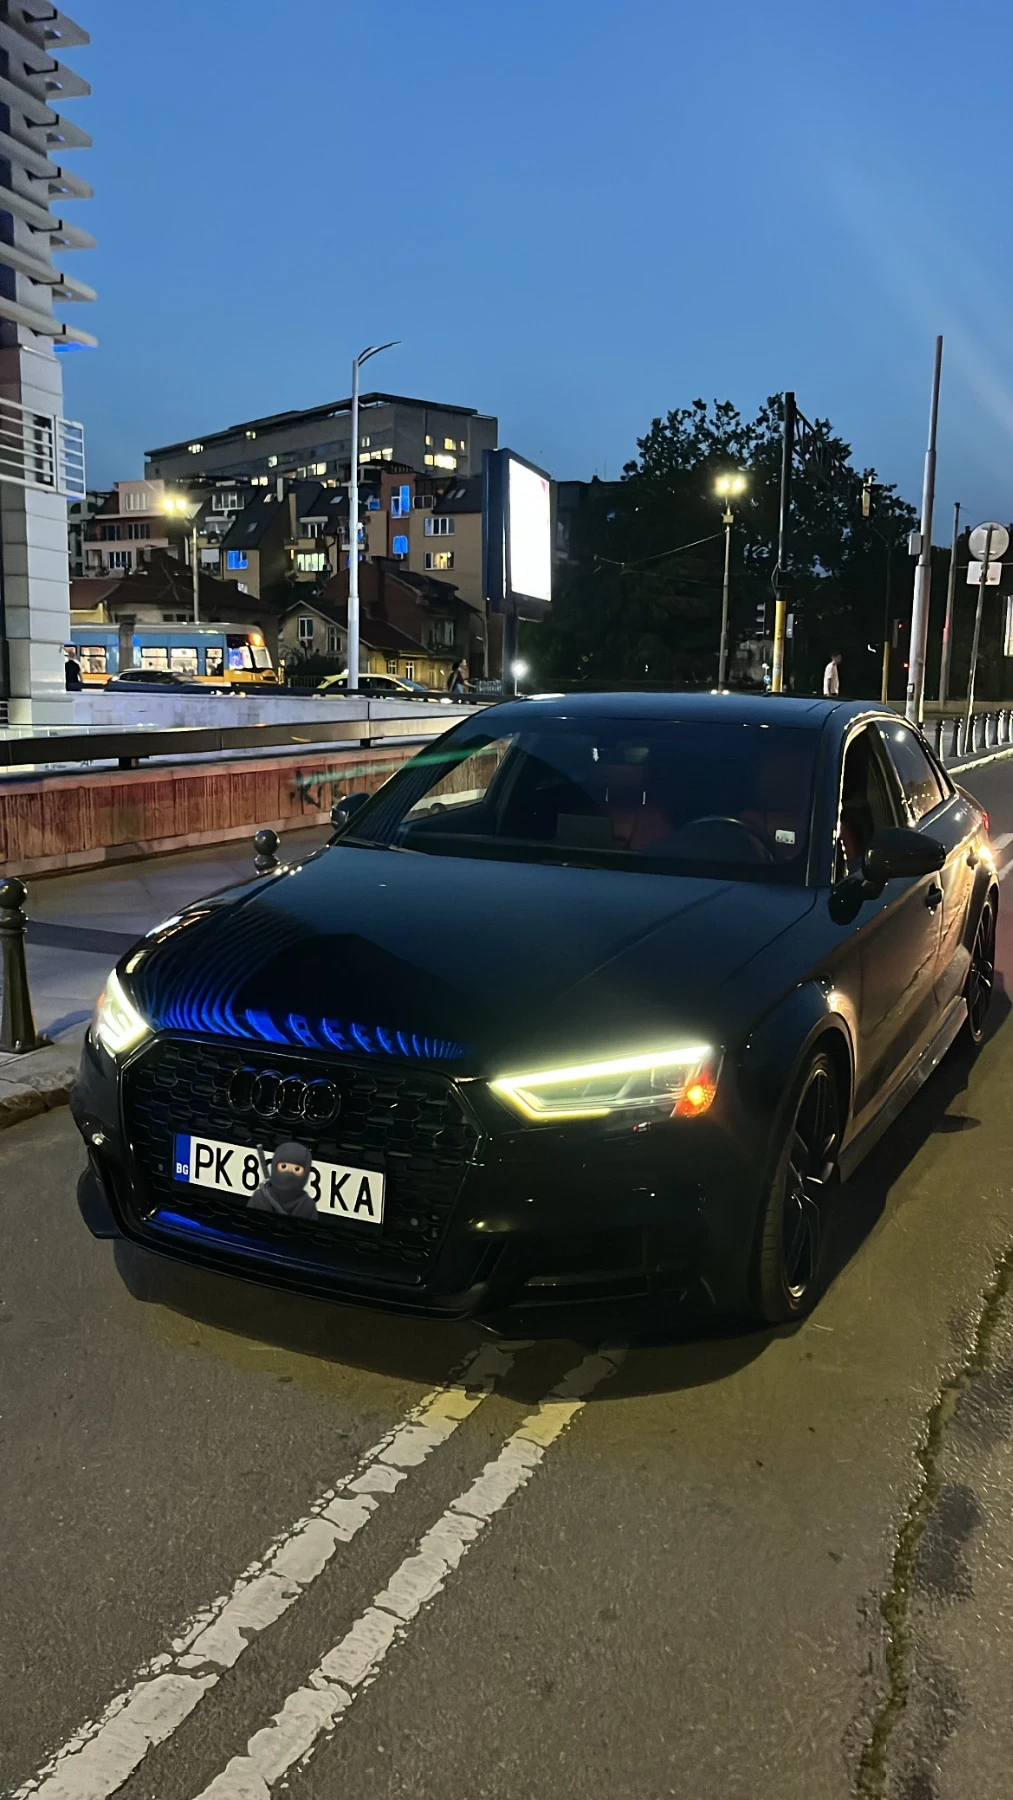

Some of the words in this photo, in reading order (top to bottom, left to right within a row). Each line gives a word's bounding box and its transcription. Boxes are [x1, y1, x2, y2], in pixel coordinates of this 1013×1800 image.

[176, 1162, 189, 1175] BG
[194, 1143, 234, 1187] PK
[242, 1154, 321, 1202] 83
[329, 1170, 374, 1216] KA
